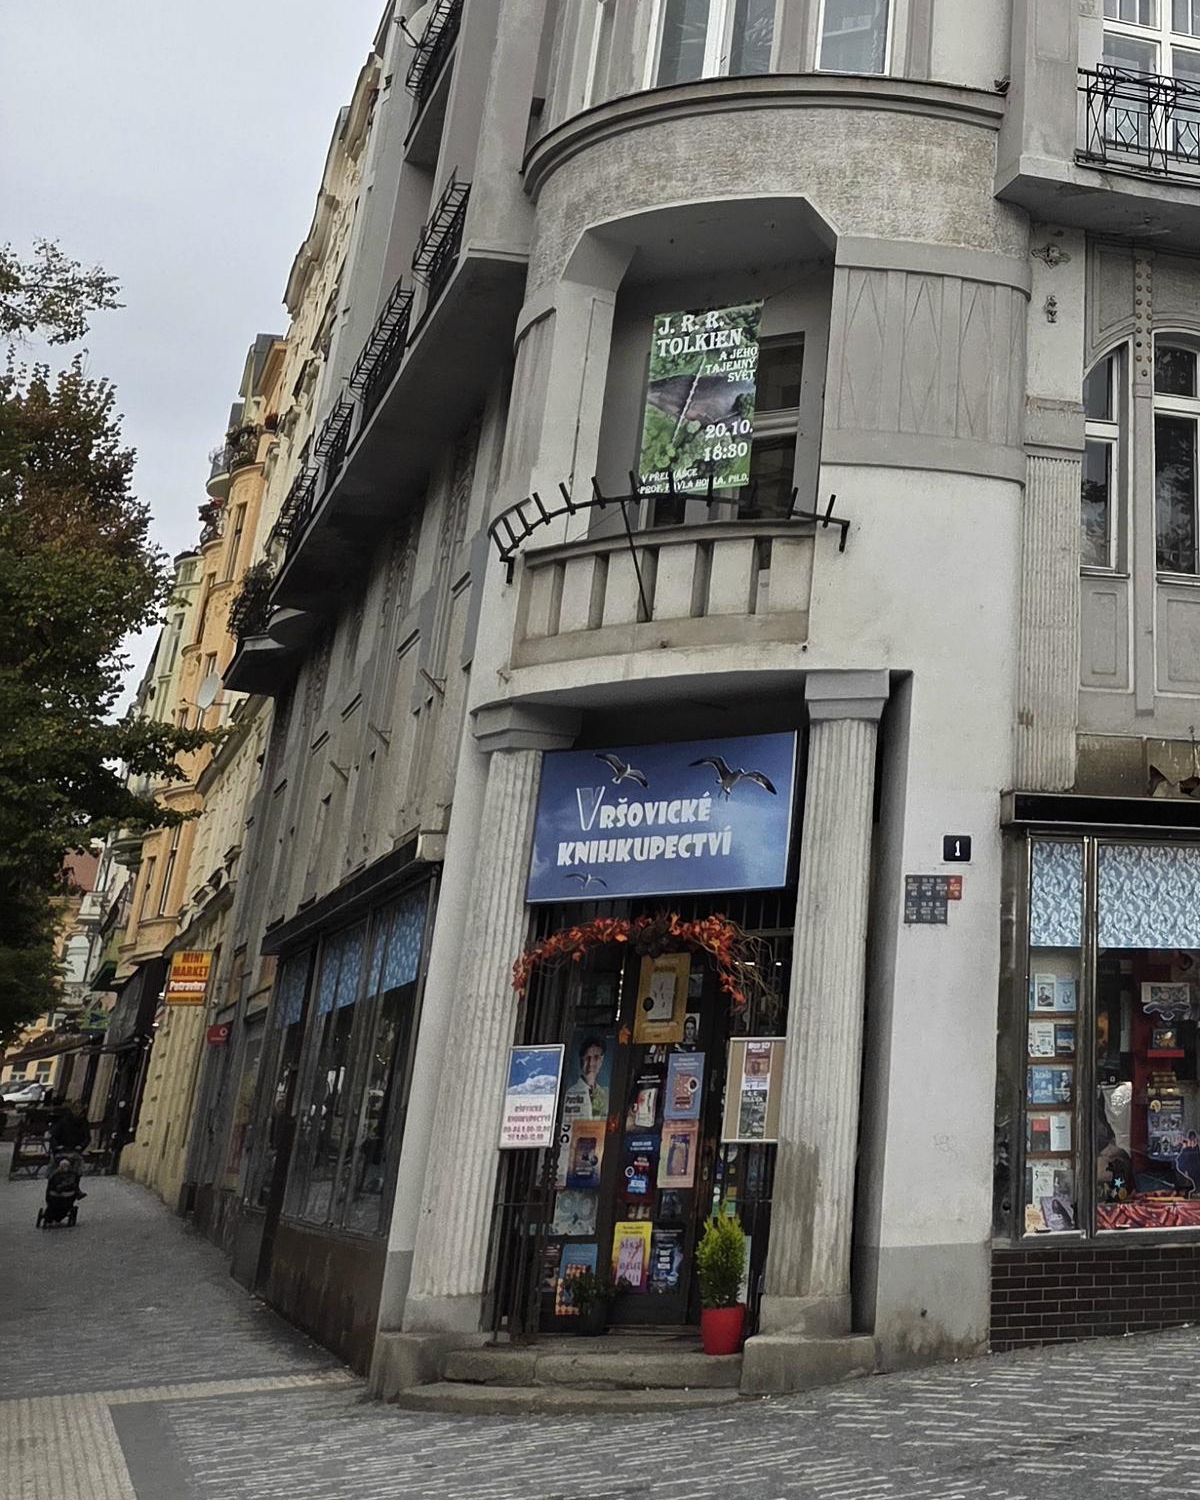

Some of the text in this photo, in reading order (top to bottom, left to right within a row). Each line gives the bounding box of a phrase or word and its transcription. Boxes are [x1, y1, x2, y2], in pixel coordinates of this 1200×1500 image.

[658, 311, 725, 336] J. R. R.
[657, 328, 743, 357] TOLKIEN
[719, 346, 758, 361] A JEHO
[704, 419, 753, 441] 20.10.
[576, 786, 712, 831] VRŠOVICKÉ
[557, 825, 733, 866] KNIHKUPECTVÍ
[955, 840, 960, 857] 1
[182, 952, 204, 964] MINI
[172, 965, 209, 978] MARKET
